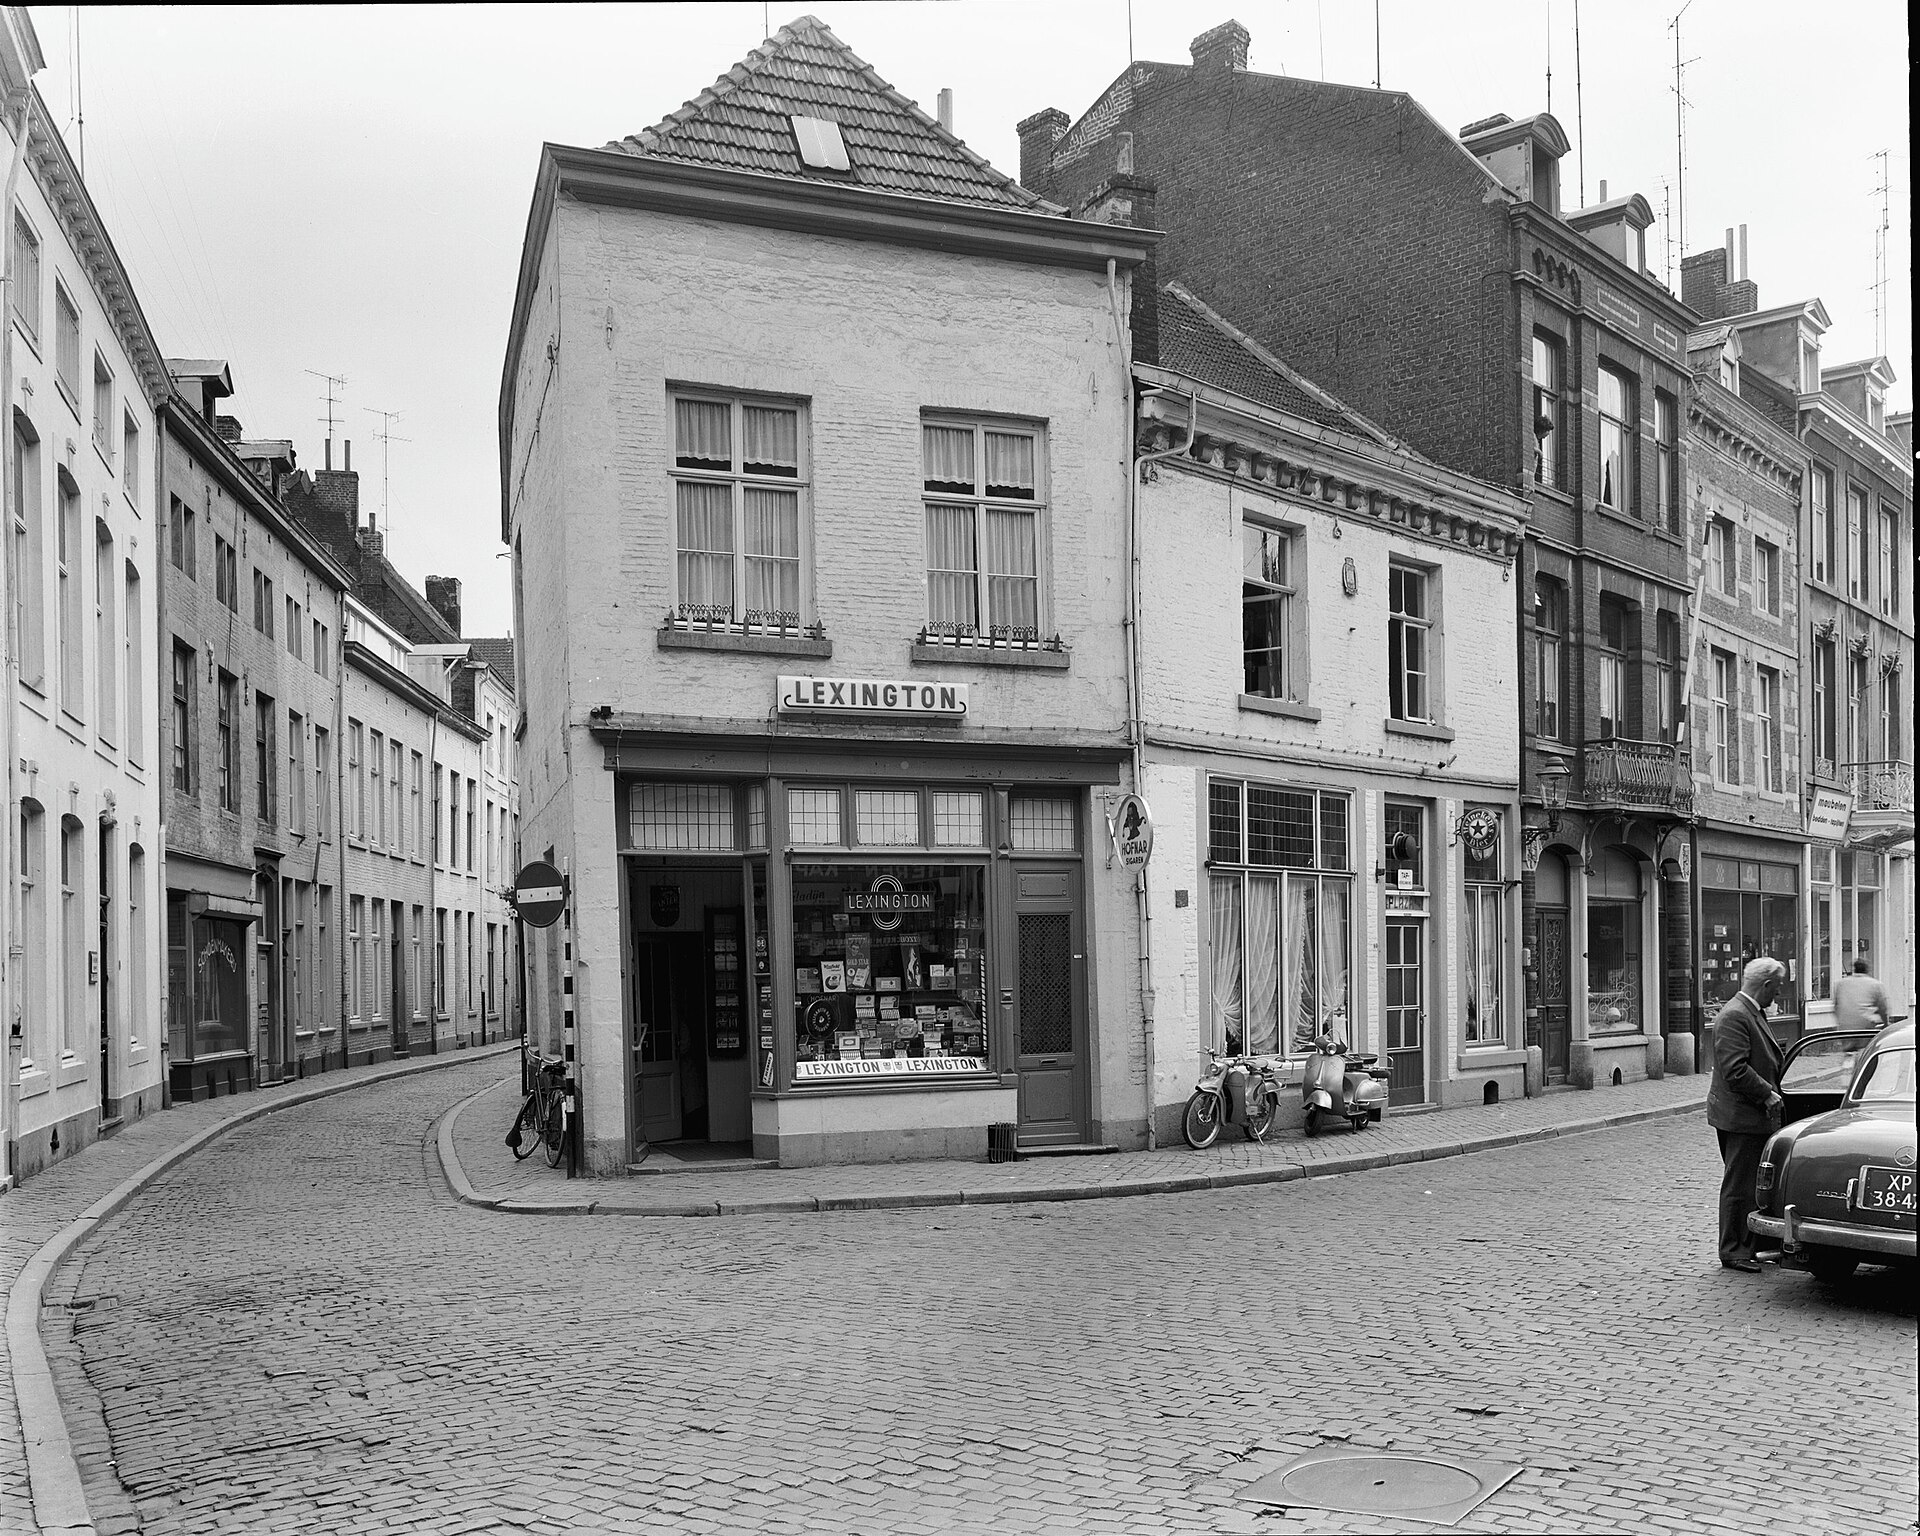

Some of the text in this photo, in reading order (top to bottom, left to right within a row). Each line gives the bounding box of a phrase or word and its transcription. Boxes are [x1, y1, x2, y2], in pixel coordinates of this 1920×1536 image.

[795, 680, 956, 710] LEXINGTON
[1463, 810, 1494, 834] Heineken's
[1121, 839, 1148, 856] HOFNAR
[1469, 837, 1489, 848] Bier
[1125, 856, 1144, 866] SIGAREN
[848, 893, 930, 910] LEXINGTON
[1388, 896, 1415, 910] PLAZA
[805, 1058, 979, 1076] LEXINGTON LEXINGTON
[1887, 1174, 1913, 1192] XP
